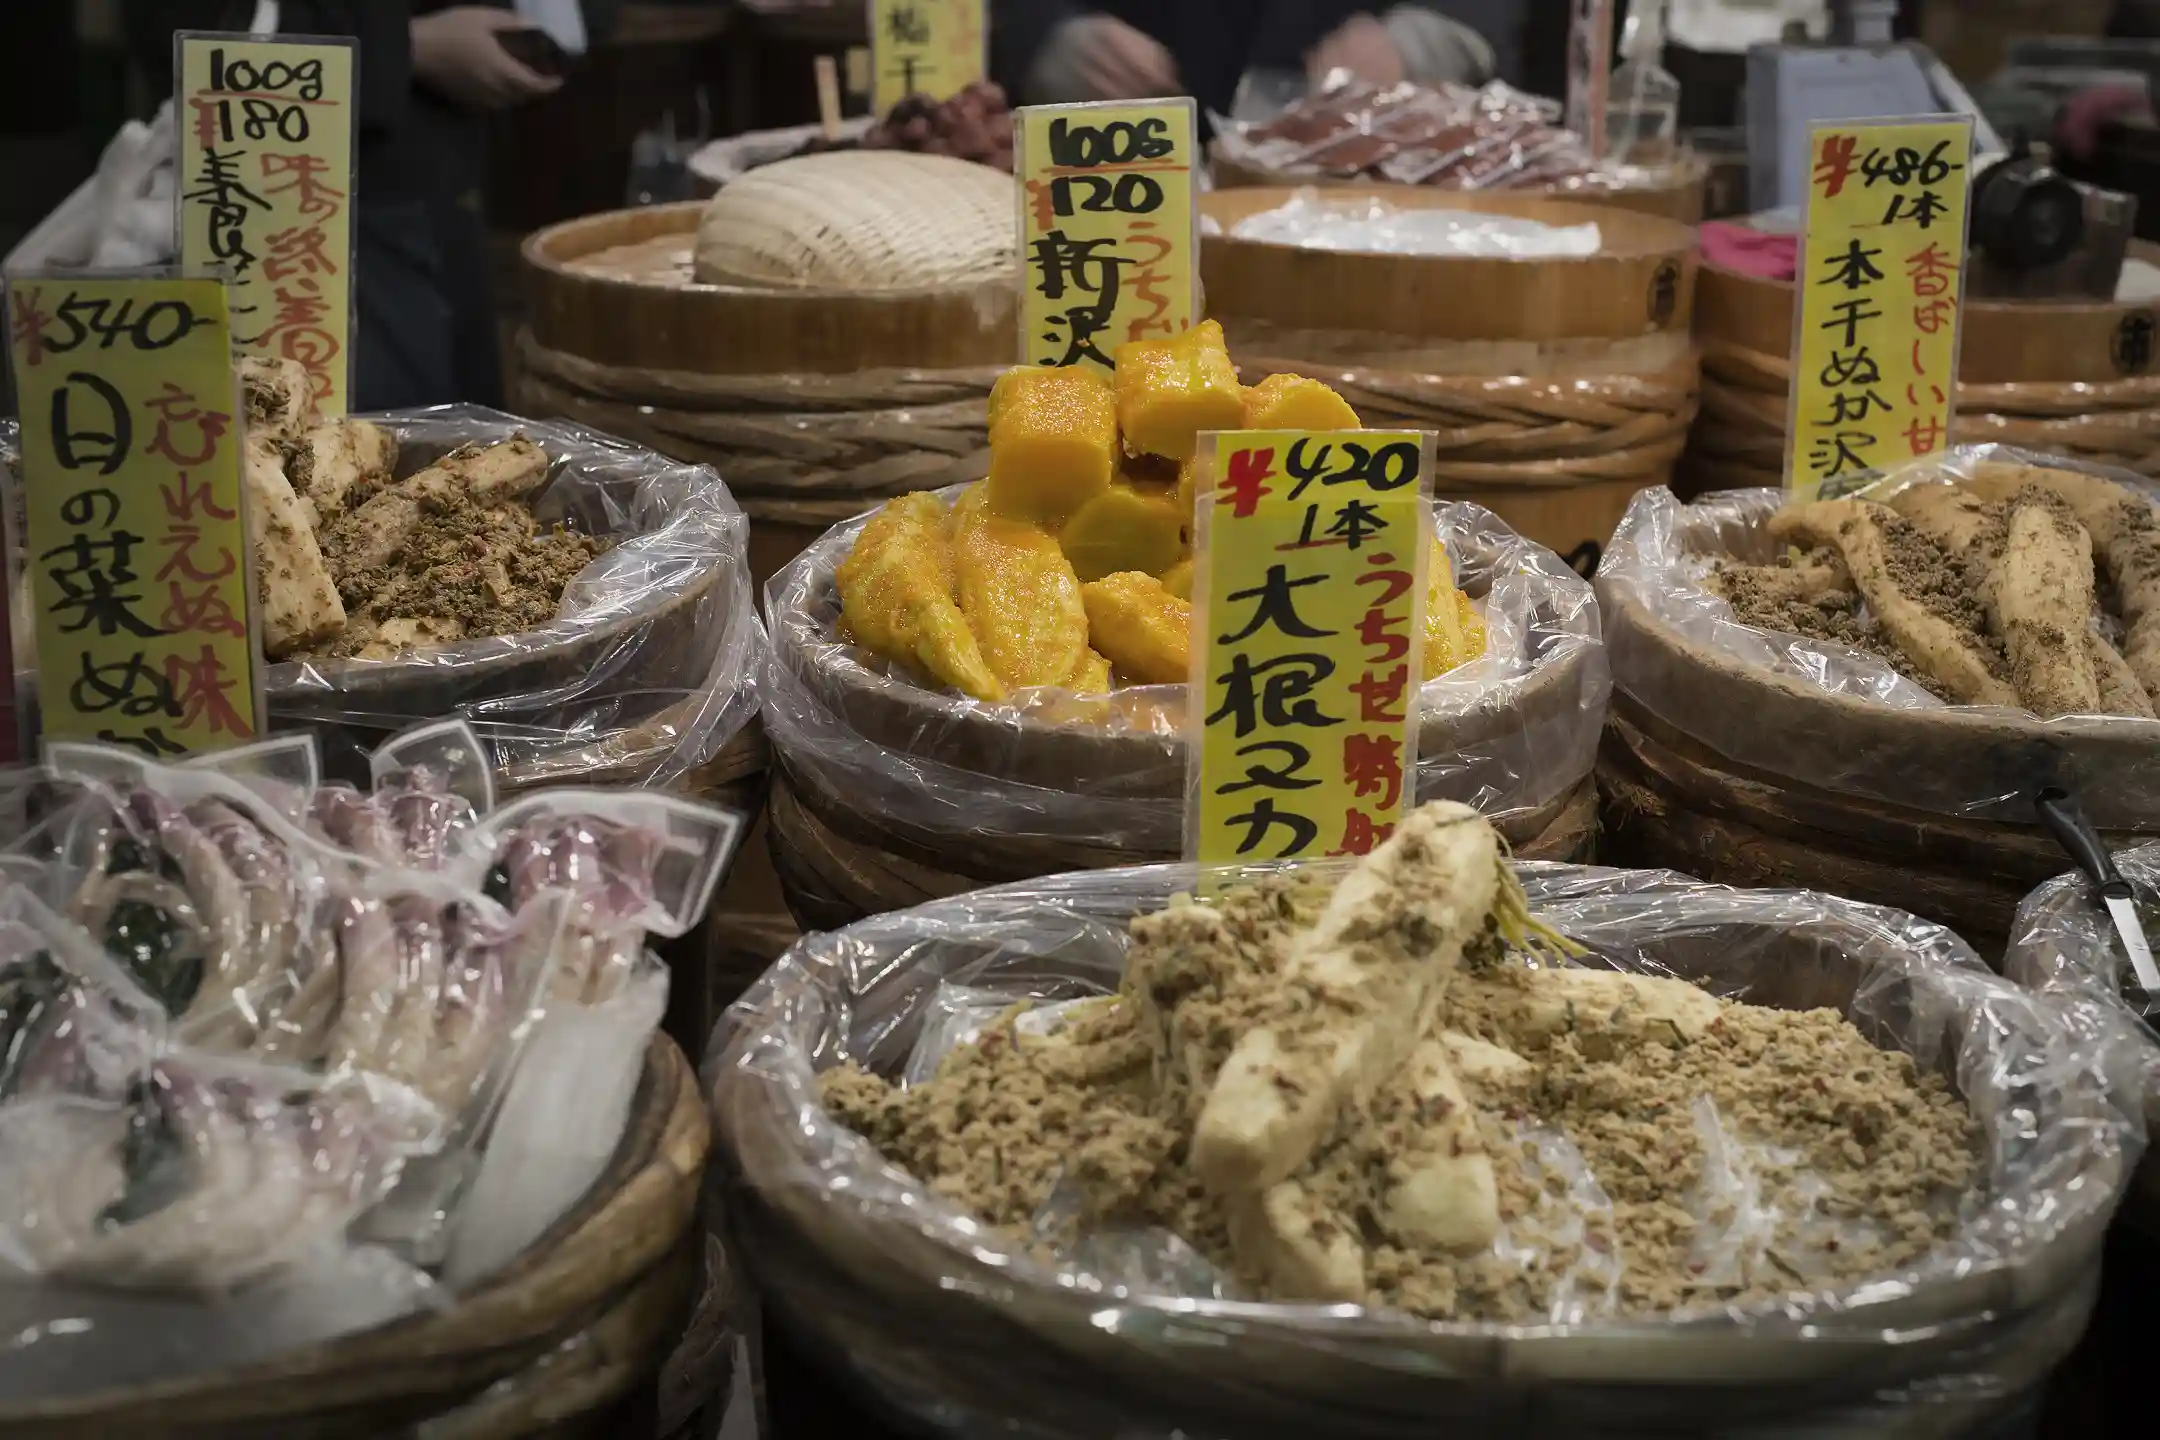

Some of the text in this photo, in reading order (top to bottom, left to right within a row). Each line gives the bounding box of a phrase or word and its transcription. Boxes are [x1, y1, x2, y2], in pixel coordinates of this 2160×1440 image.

[210, 48, 324, 101] 100g
[1881, 189, 1950, 229] 1本
[1216, 436, 1420, 518] ¥420
[1298, 499, 1389, 550] 1本
